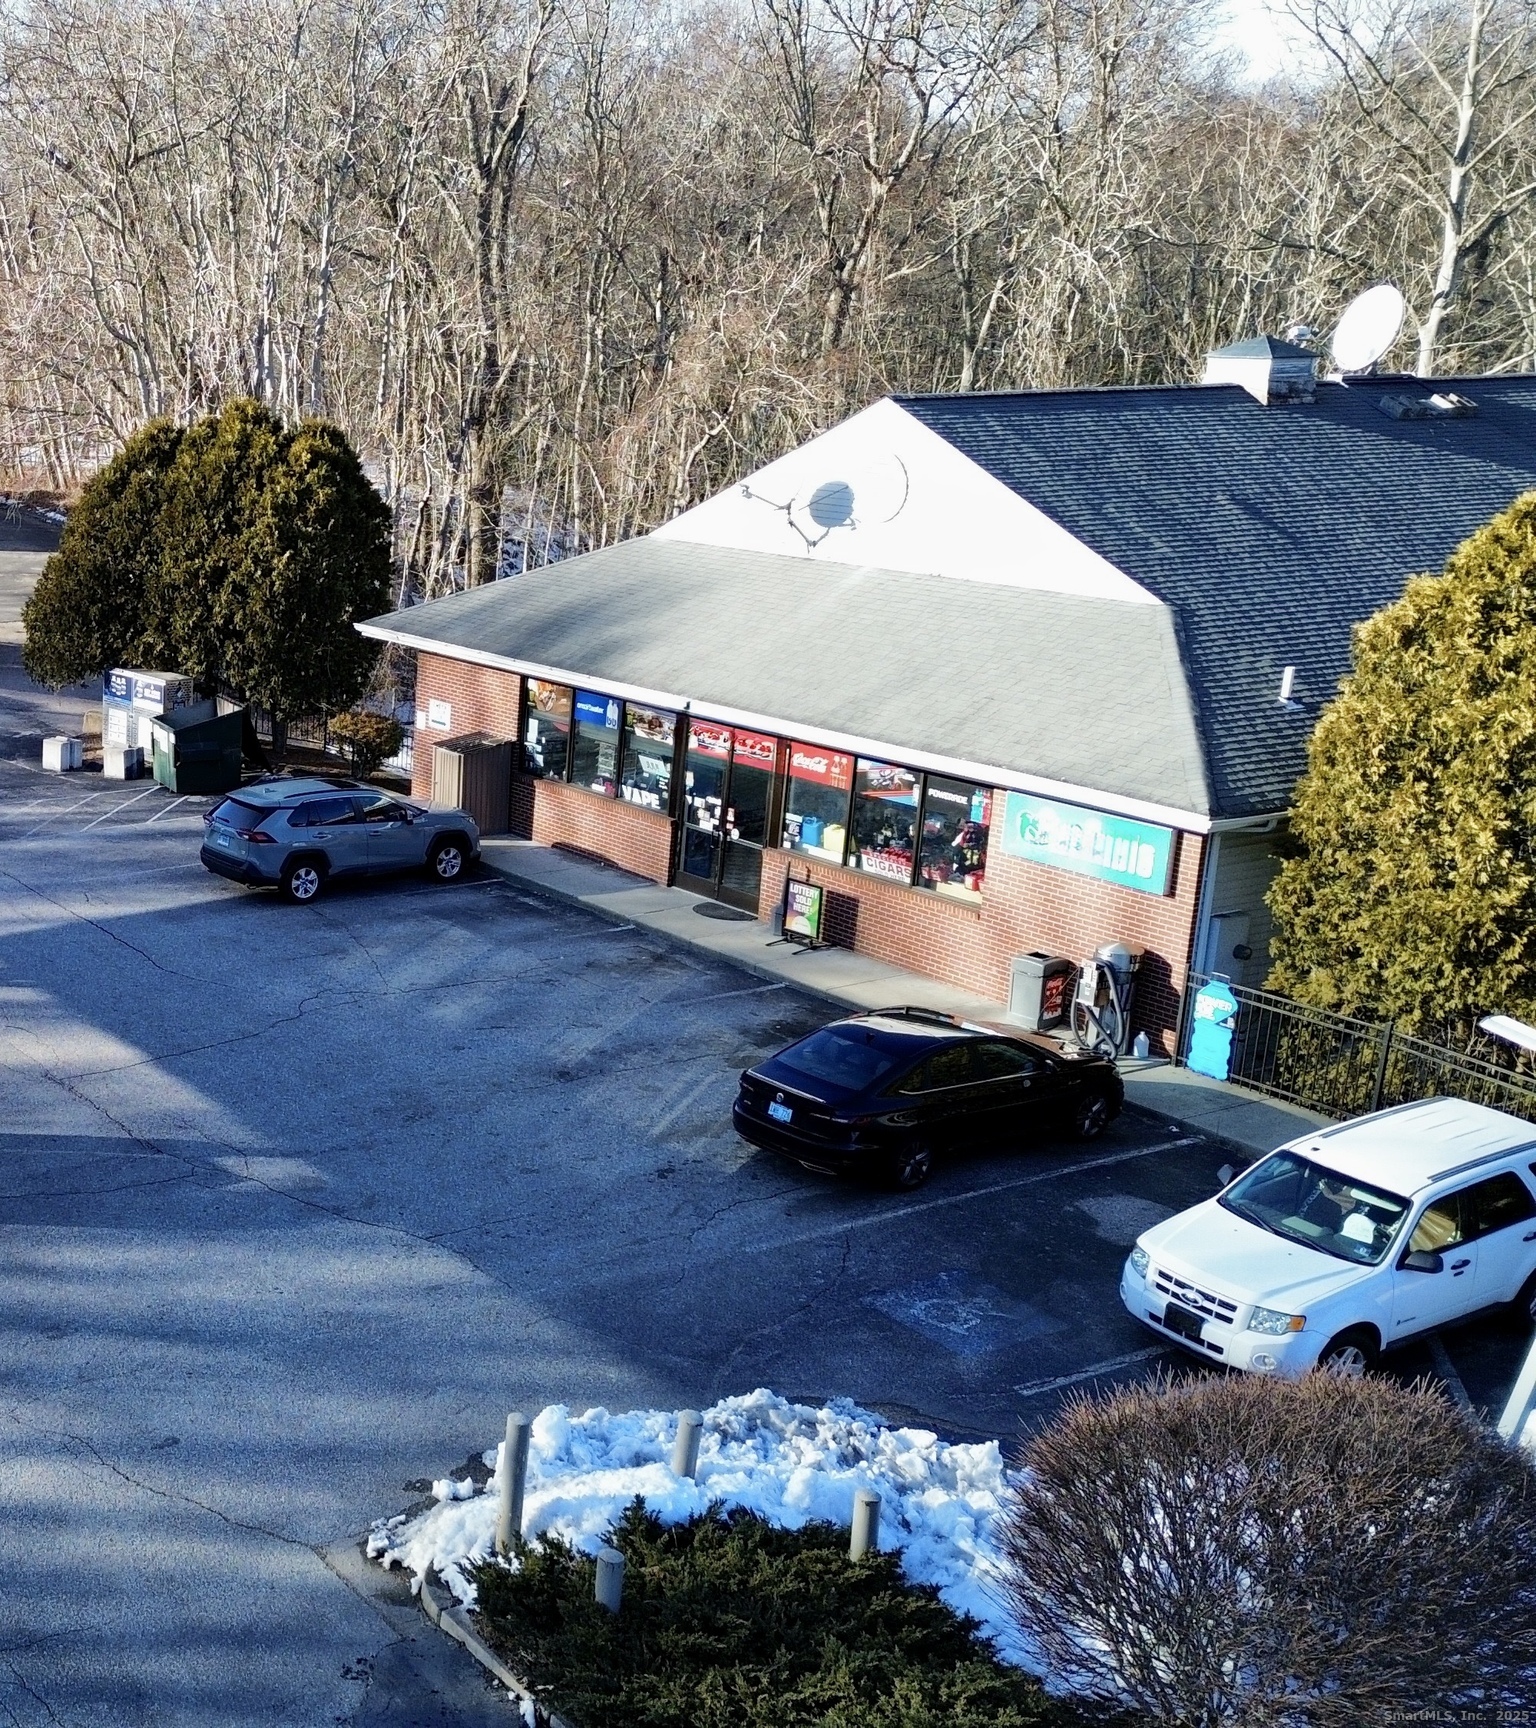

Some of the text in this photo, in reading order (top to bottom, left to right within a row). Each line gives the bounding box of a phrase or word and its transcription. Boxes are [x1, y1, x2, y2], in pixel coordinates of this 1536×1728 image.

[622, 784, 661, 810] VAPE
[928, 788, 968, 805] POWERADE
[866, 857, 912, 878] CIGARS
[790, 882, 820, 899] LOTTERY
[796, 894, 812, 906] SOLD
